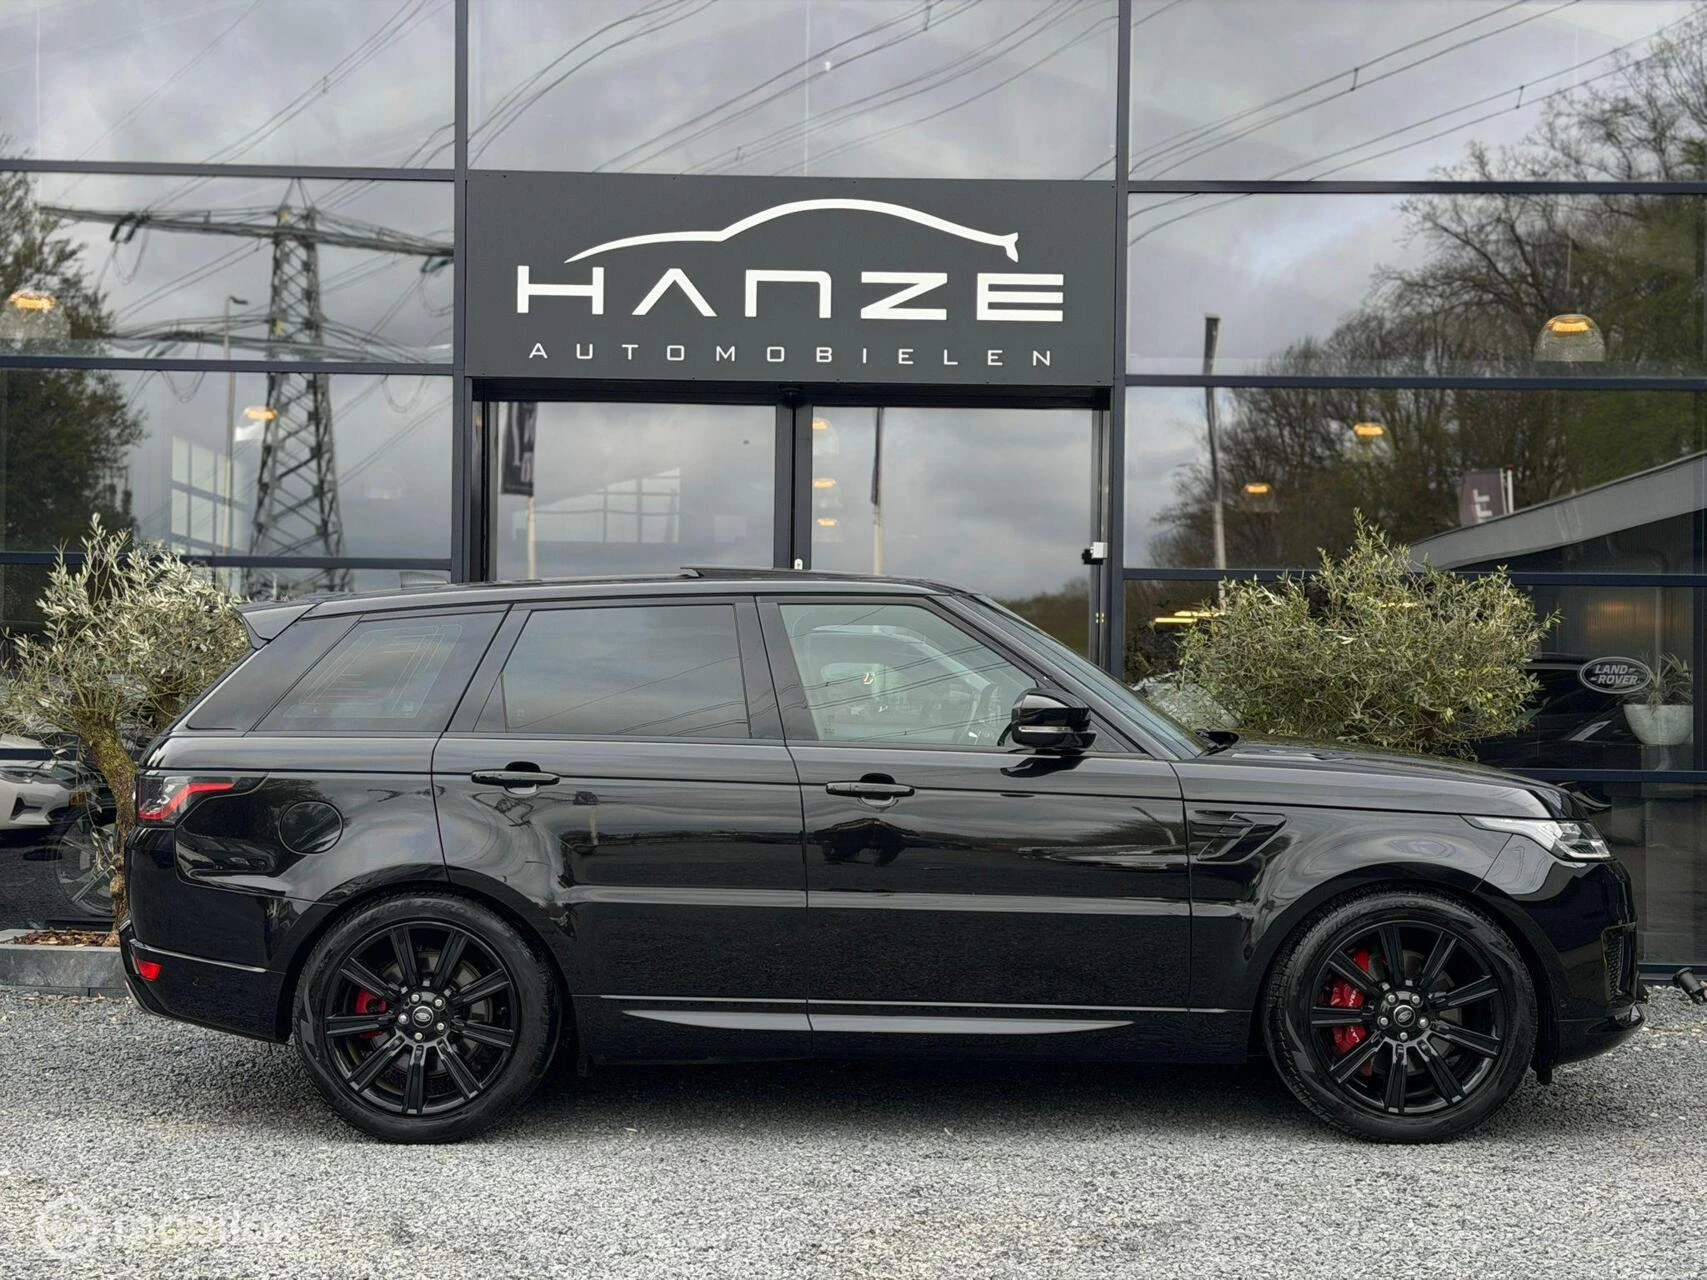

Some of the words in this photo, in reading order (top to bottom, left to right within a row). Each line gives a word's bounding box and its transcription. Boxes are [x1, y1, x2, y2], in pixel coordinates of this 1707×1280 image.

[517, 265, 1064, 322] HANZE
[528, 342, 1052, 367] AUTOMOBIELEN
[1595, 664, 1629, 674] LAND
[1597, 675, 1640, 685] ROVER
